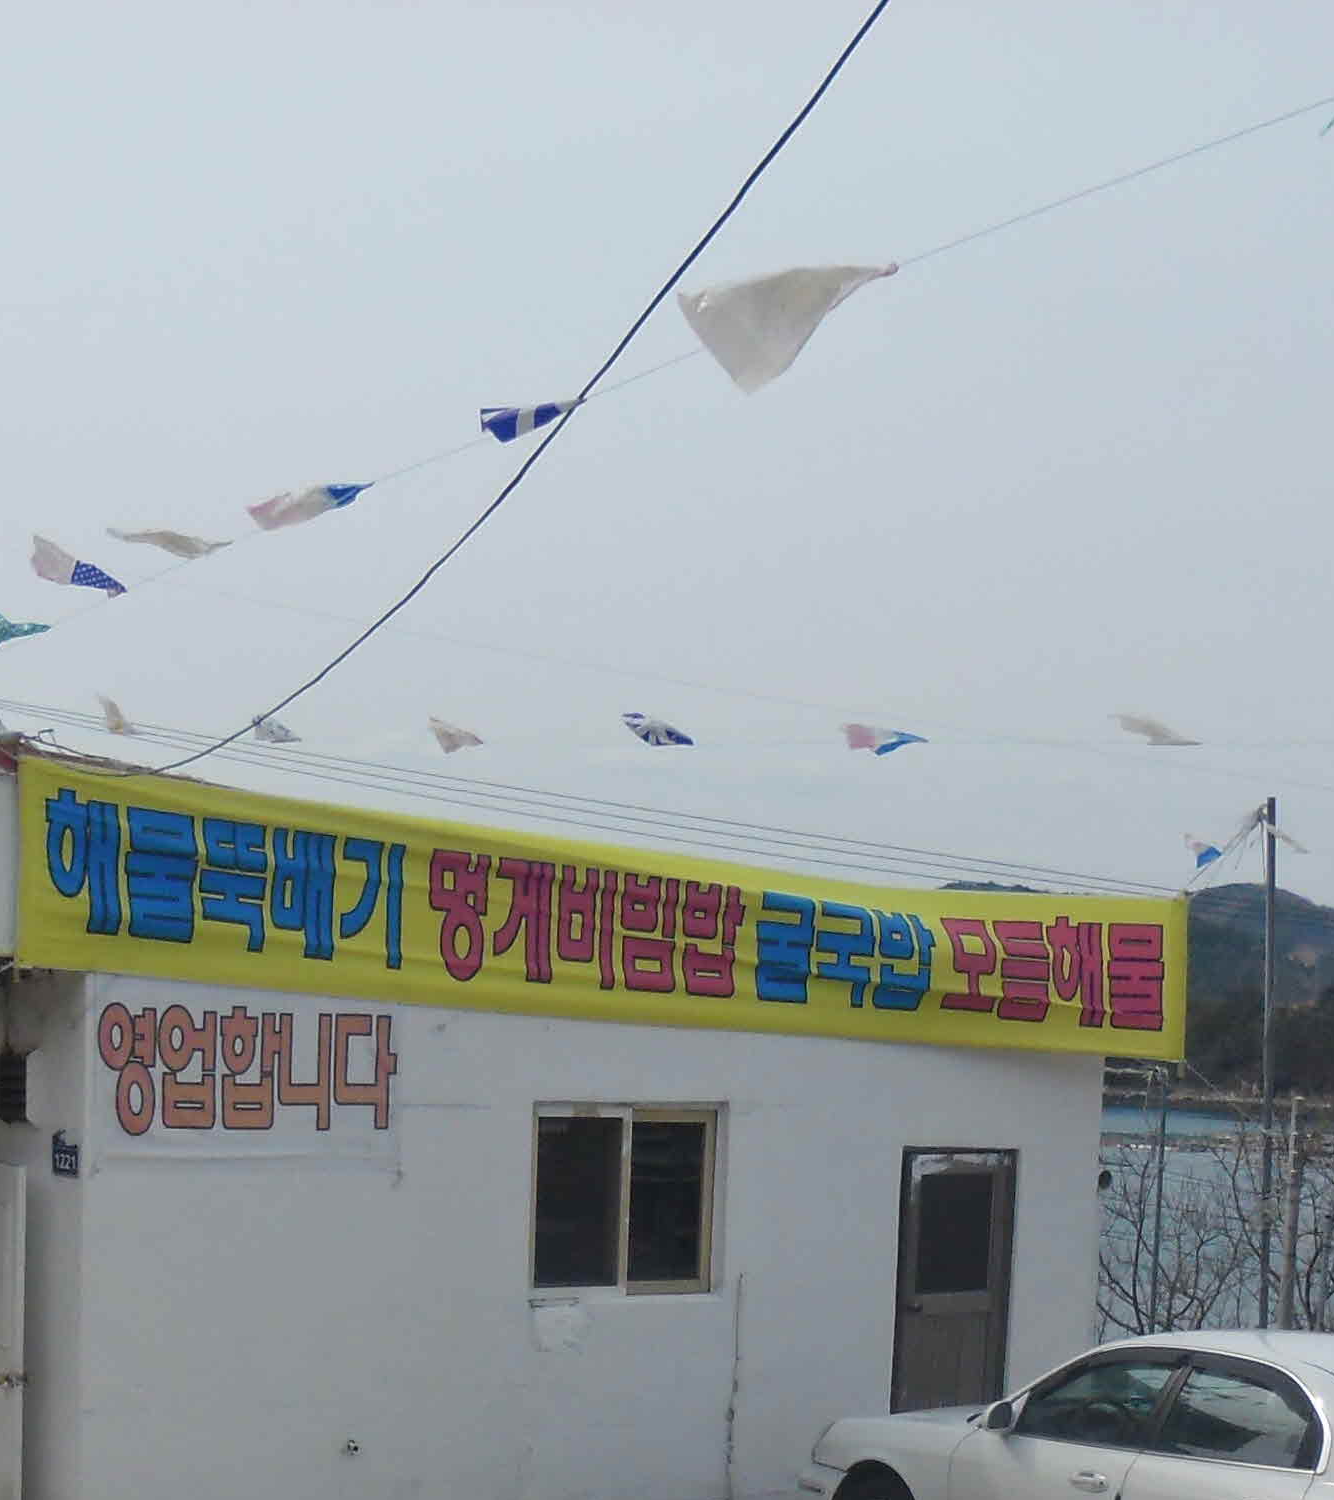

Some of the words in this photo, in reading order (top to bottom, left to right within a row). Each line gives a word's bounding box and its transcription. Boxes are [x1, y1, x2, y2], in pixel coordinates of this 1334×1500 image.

[45, 788, 406, 970] 해물뚝배기
[429, 848, 746, 998] 멍게비빔밥
[755, 891, 937, 1011] 굴국밥
[939, 916, 1165, 1032] 모듬해물
[98, 1002, 397, 1136] 영업합니다
